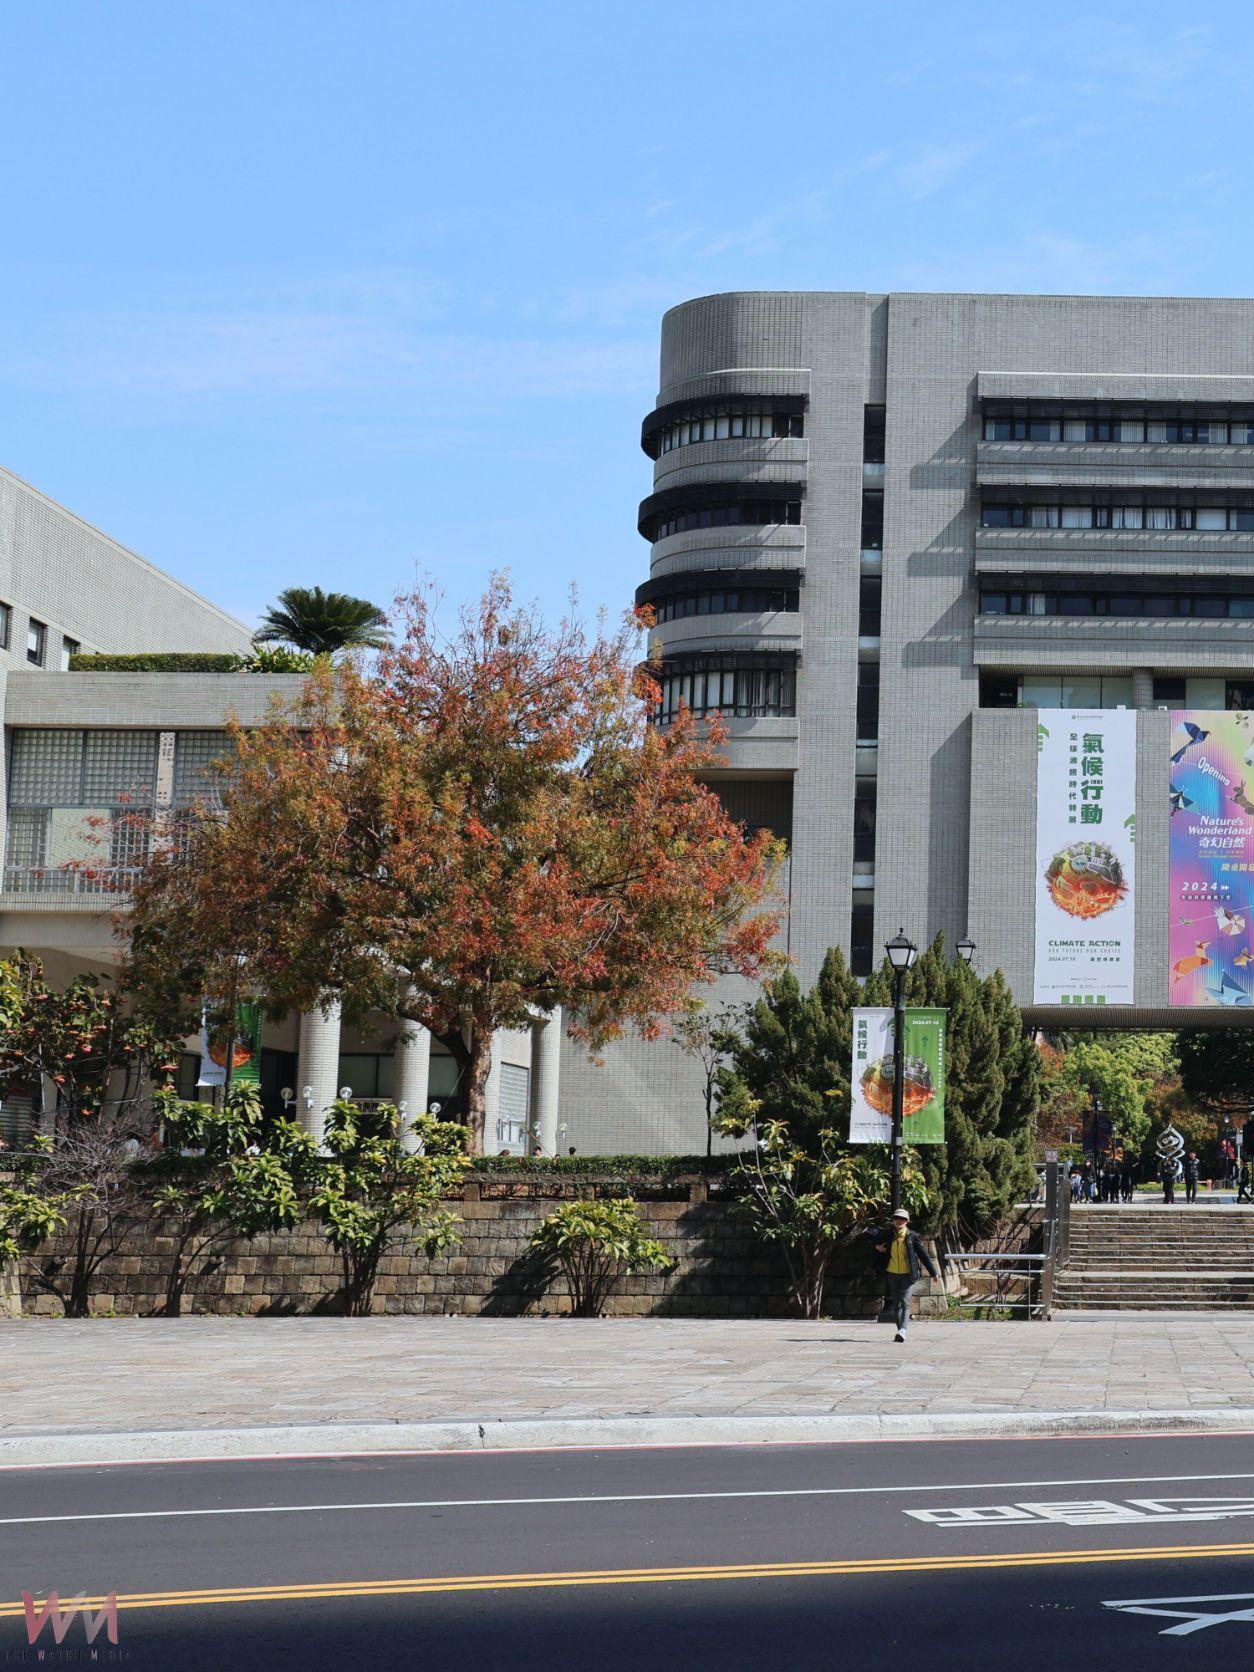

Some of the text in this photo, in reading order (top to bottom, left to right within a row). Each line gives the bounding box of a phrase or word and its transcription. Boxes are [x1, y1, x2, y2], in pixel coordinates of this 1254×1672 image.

[1197, 757, 1231, 786] Opening
[1080, 733, 1104, 825] 氣候行動
[1200, 815, 1244, 826] Nature's
[1188, 825, 1253, 836] Wonderland
[1199, 837, 1245, 849] 奇幻自然
[1182, 882, 1218, 892] 2024
